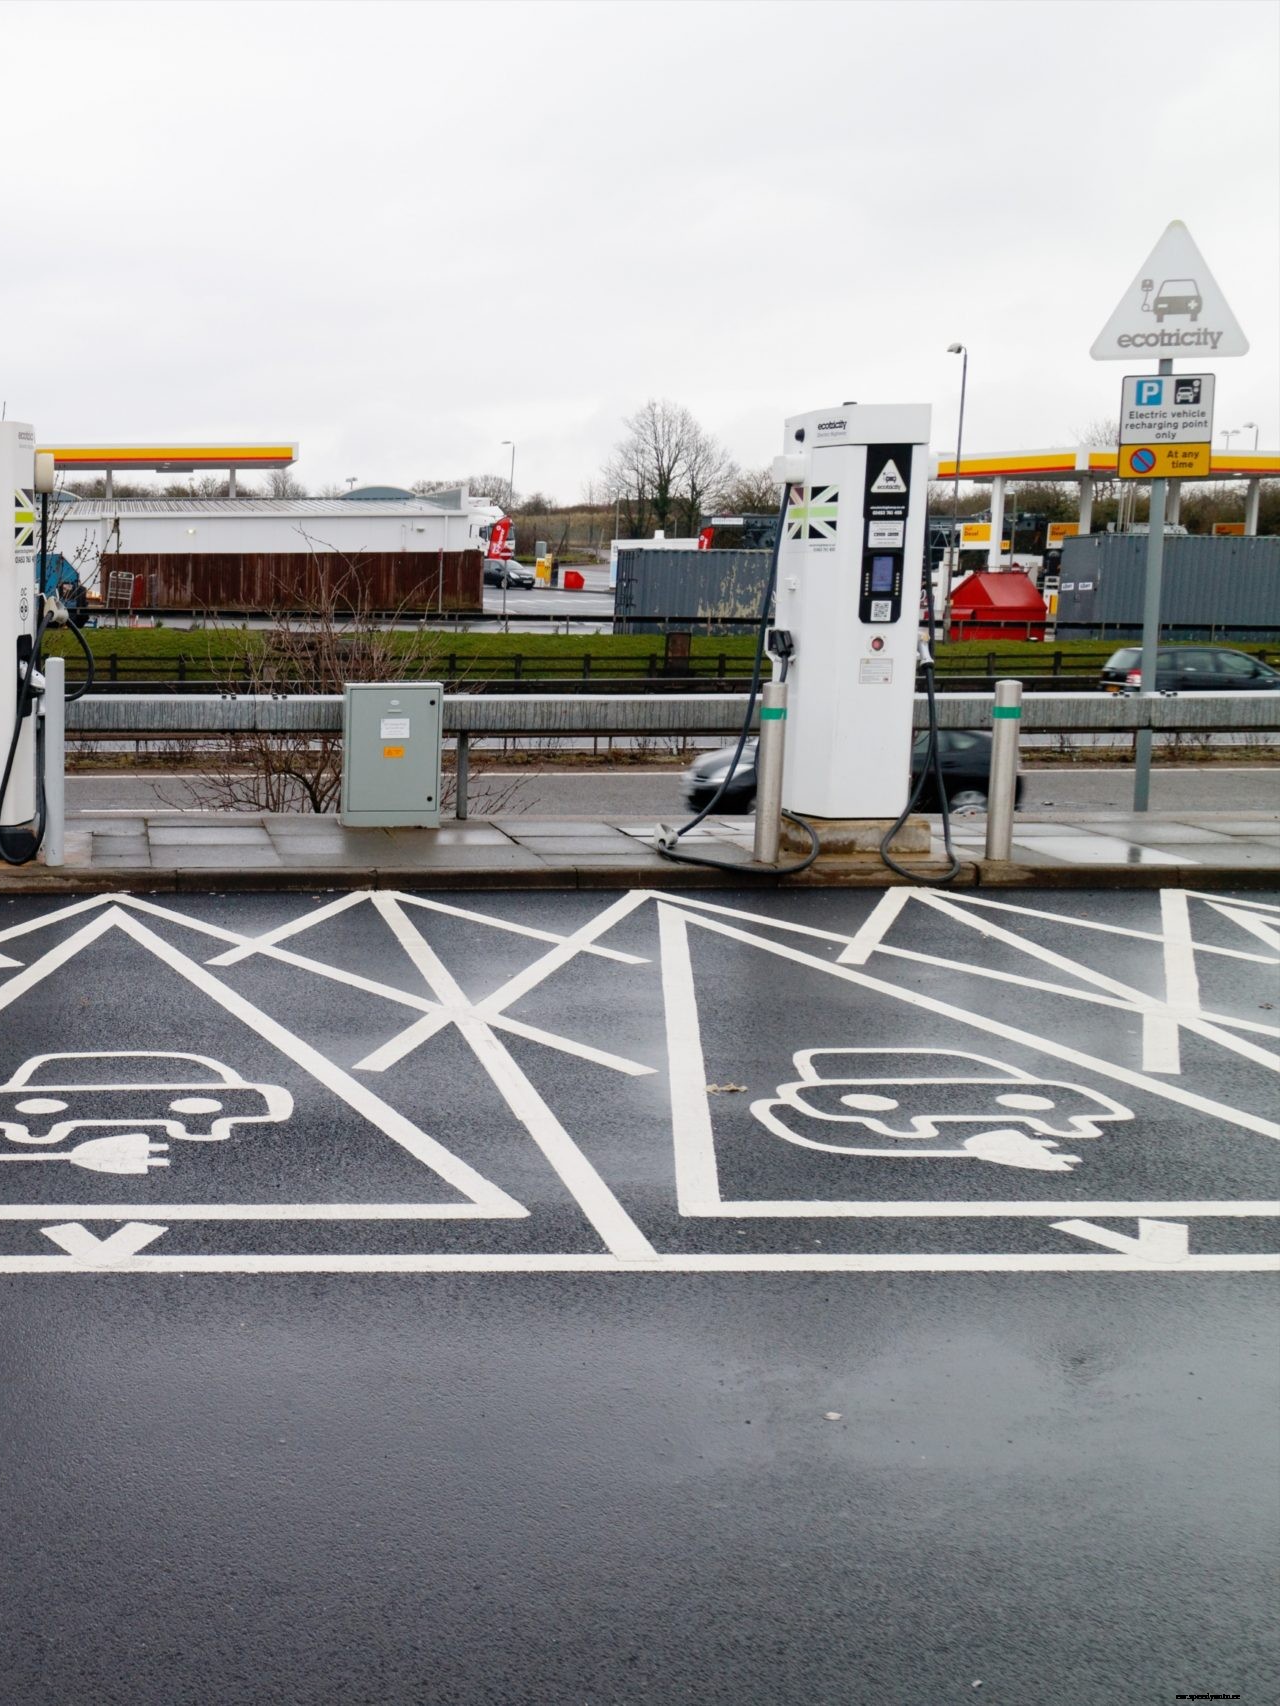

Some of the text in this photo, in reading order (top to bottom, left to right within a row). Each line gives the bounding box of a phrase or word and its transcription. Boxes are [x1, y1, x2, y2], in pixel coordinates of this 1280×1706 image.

[1117, 328, 1223, 349] ecotricity
[1141, 382, 1159, 404] P
[1129, 409, 1206, 420] Electric vehicle
[1125, 419, 1209, 431] recharging point
[1155, 431, 1177, 440] only
[1166, 450, 1200, 460] At any
[1171, 459, 1194, 469] time
